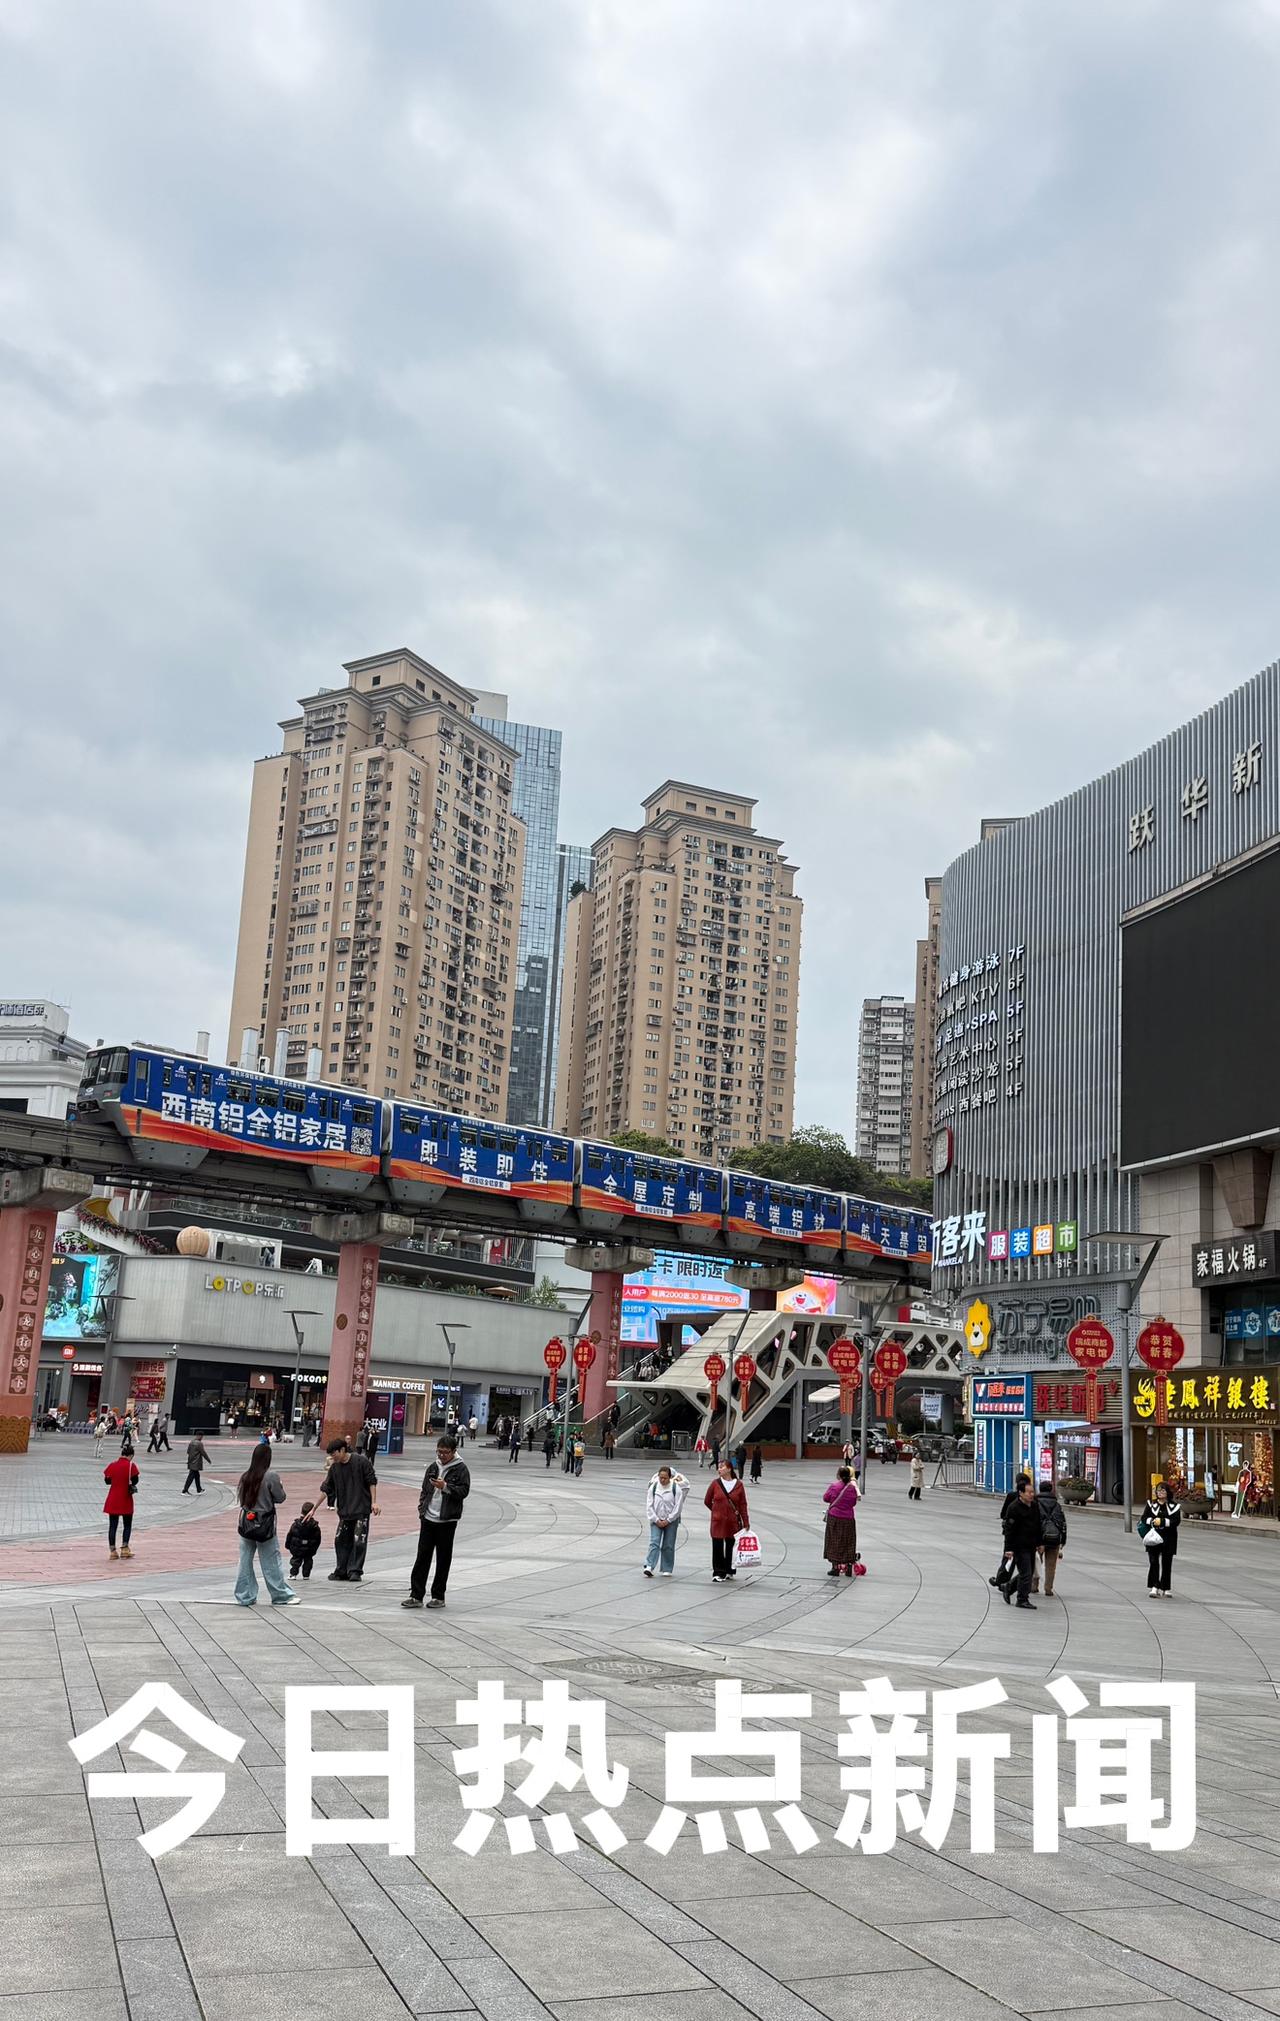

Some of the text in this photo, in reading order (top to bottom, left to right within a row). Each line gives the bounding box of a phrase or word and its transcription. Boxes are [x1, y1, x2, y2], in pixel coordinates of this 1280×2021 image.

[1008, 944, 1025, 963] 7F
[971, 974, 1024, 1005] KTV 6F
[1007, 1000, 1023, 1018] 5F
[1007, 1028, 1022, 1044] 5F
[1006, 1055, 1022, 1071] 5F
[958, 1088, 997, 1113] 西餐吧
[1006, 1082, 1022, 1098] 4F
[161, 1092, 346, 1151] 西南铝全铝家居
[420, 1139, 548, 1184] 即装即住
[603, 1174, 702, 1212] 全屋定制
[990, 1224, 1075, 1257] 服装超市
[1196, 1244, 1256, 1277] 家福火锅
[372, 1380, 426, 1391] MANNER COFFEE
